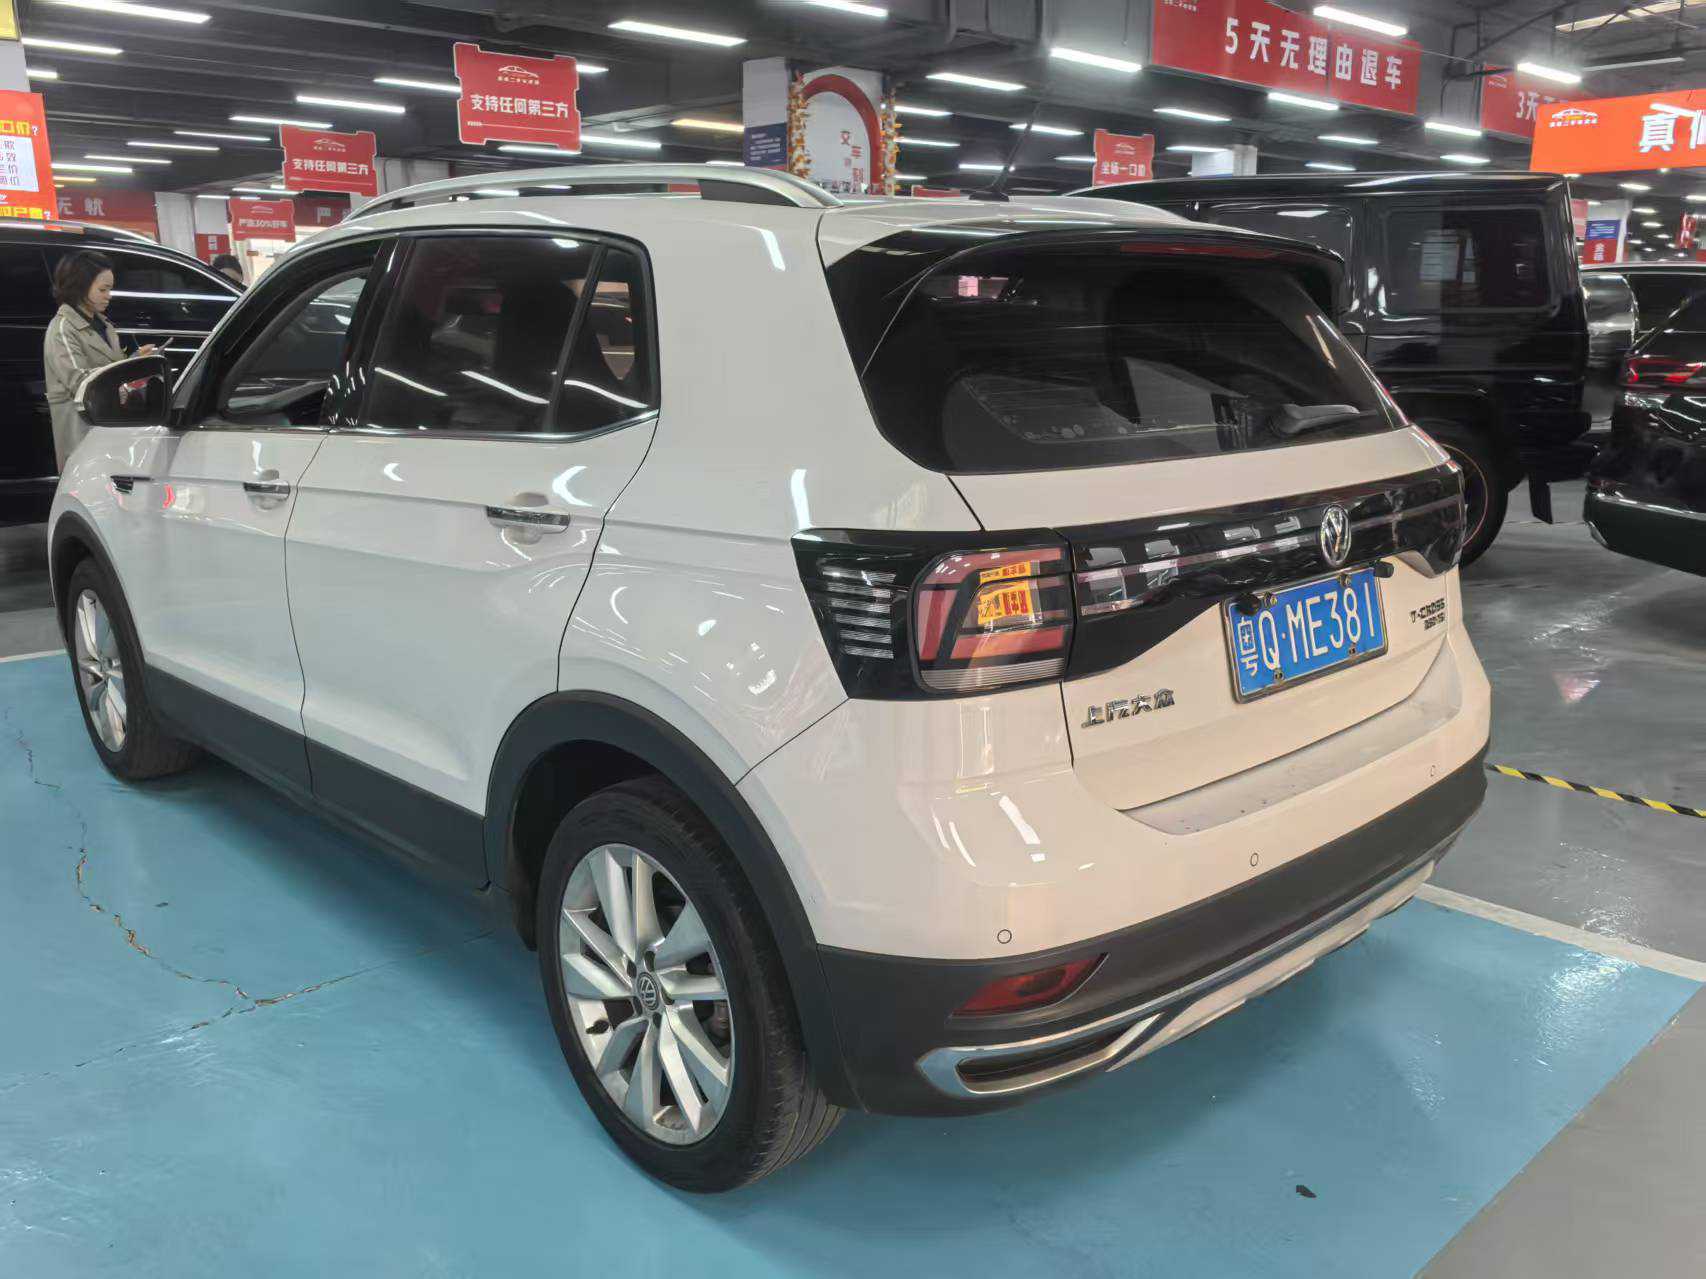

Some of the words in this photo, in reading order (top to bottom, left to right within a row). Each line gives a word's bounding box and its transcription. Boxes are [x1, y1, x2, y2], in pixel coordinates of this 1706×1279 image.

[1224, 16, 1402, 90] 5天无理由退车
[470, 93, 569, 119] 支持任何第三方
[1081, 688, 1175, 728] 上汽大众
